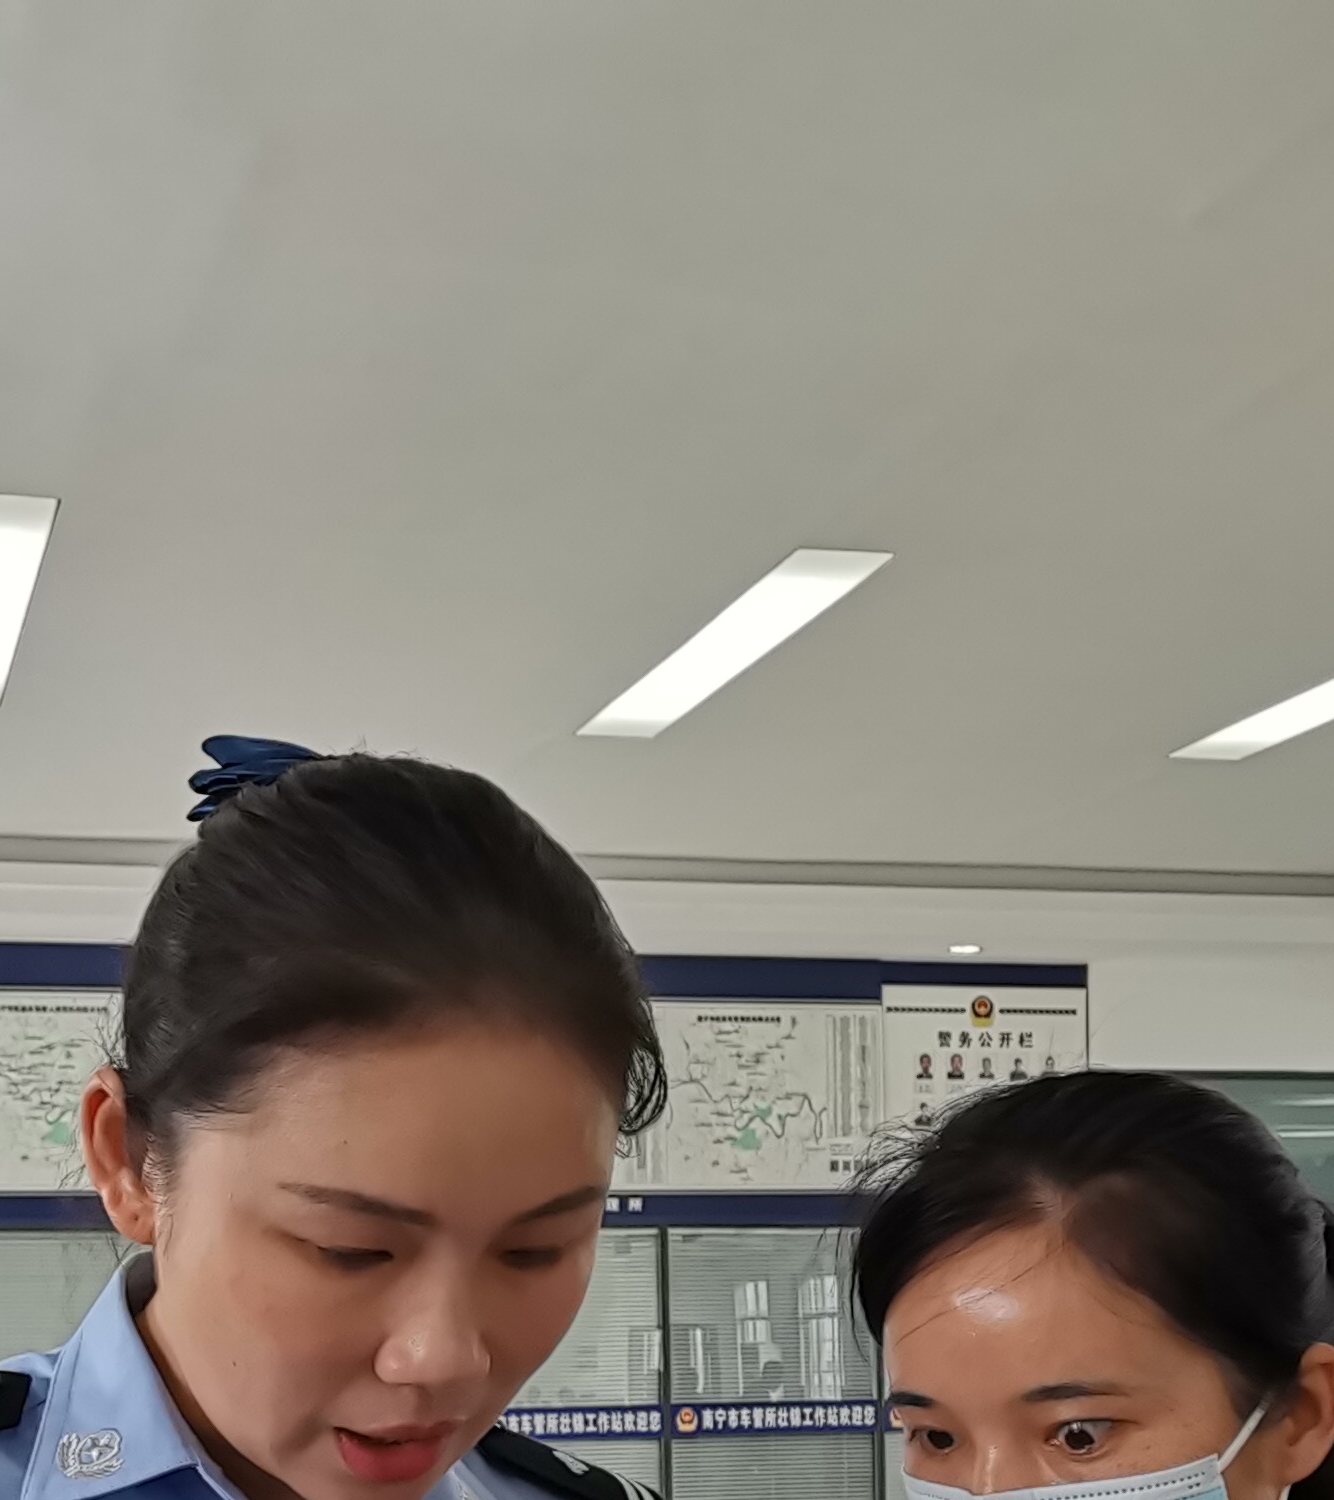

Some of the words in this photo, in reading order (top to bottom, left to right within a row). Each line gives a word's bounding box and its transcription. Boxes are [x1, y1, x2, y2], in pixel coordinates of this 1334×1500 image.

[938, 1031, 1034, 1048] 警务公开栏
